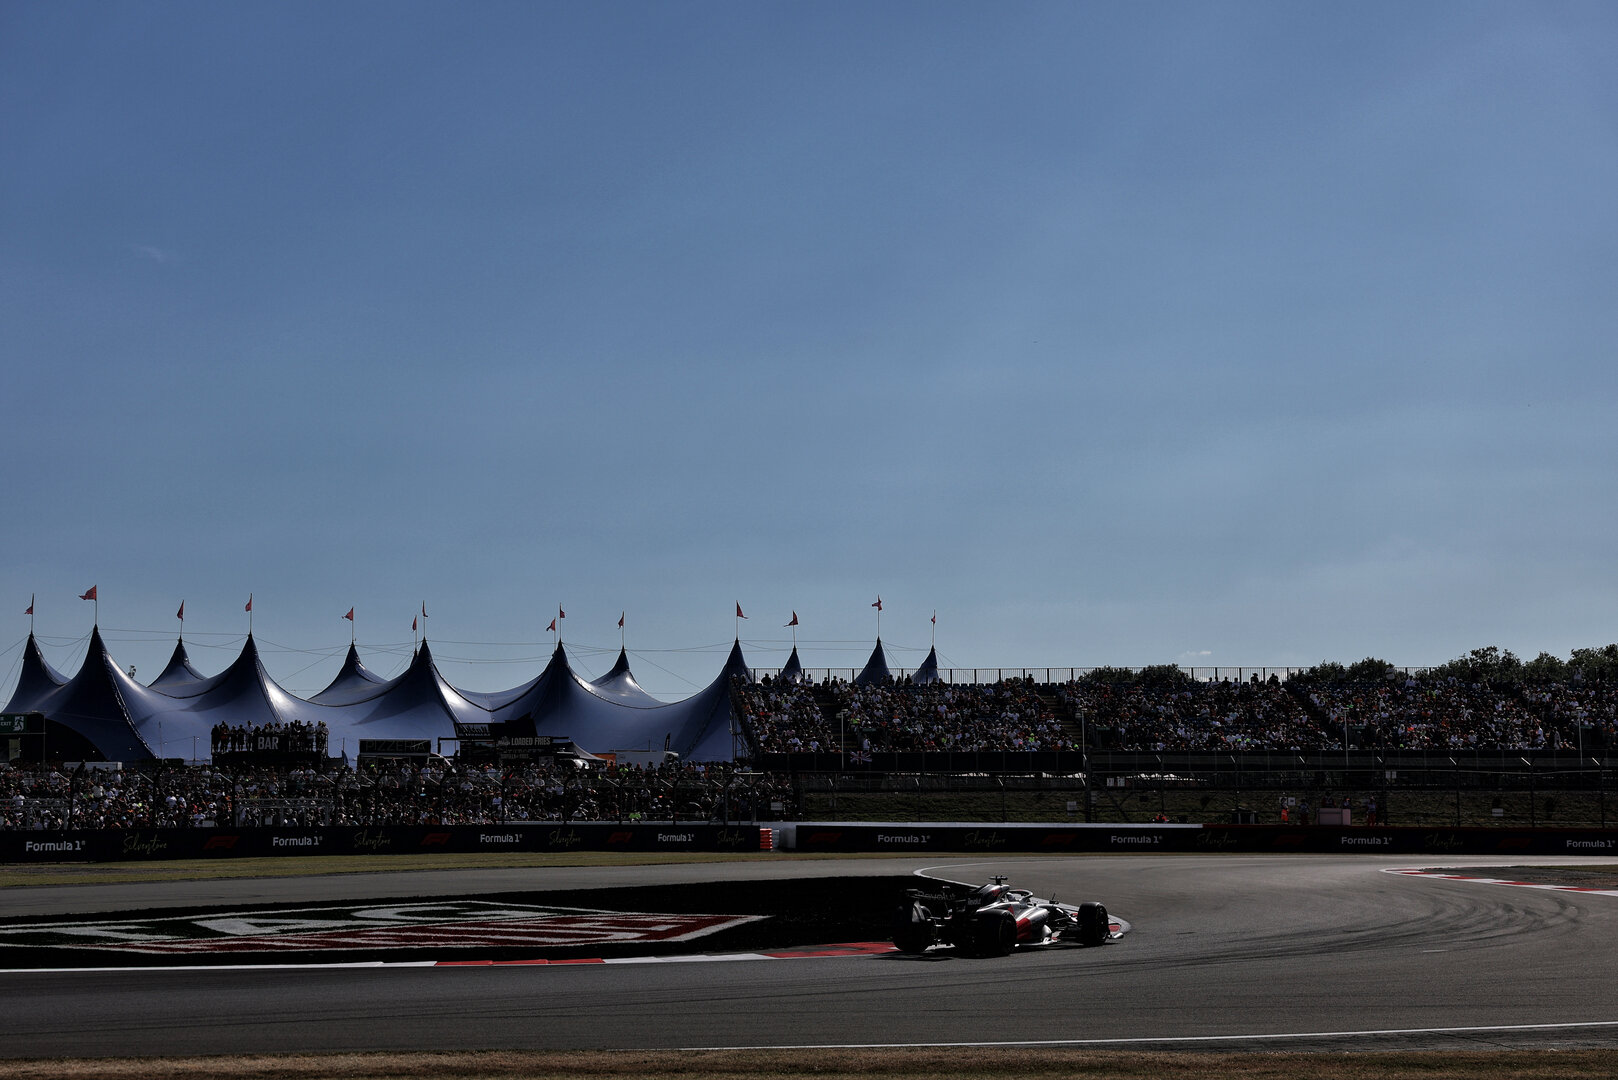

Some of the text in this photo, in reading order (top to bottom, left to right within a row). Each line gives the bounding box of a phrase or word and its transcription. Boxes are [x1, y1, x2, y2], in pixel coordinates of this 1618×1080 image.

[257, 736, 279, 750] BAR
[511, 737, 533, 746] LOADED
[534, 736, 551, 746] FRIES
[366, 740, 425, 752] PIZZERIA
[272, 836, 312, 847] Formula
[479, 834, 513, 843] Formula
[657, 833, 687, 842] Formula
[877, 834, 919, 843] Formula
[1110, 835, 1151, 844] Formula
[1341, 836, 1382, 845] Formula
[25, 841, 73, 852] Formula
[1566, 839, 1606, 848] Formula
